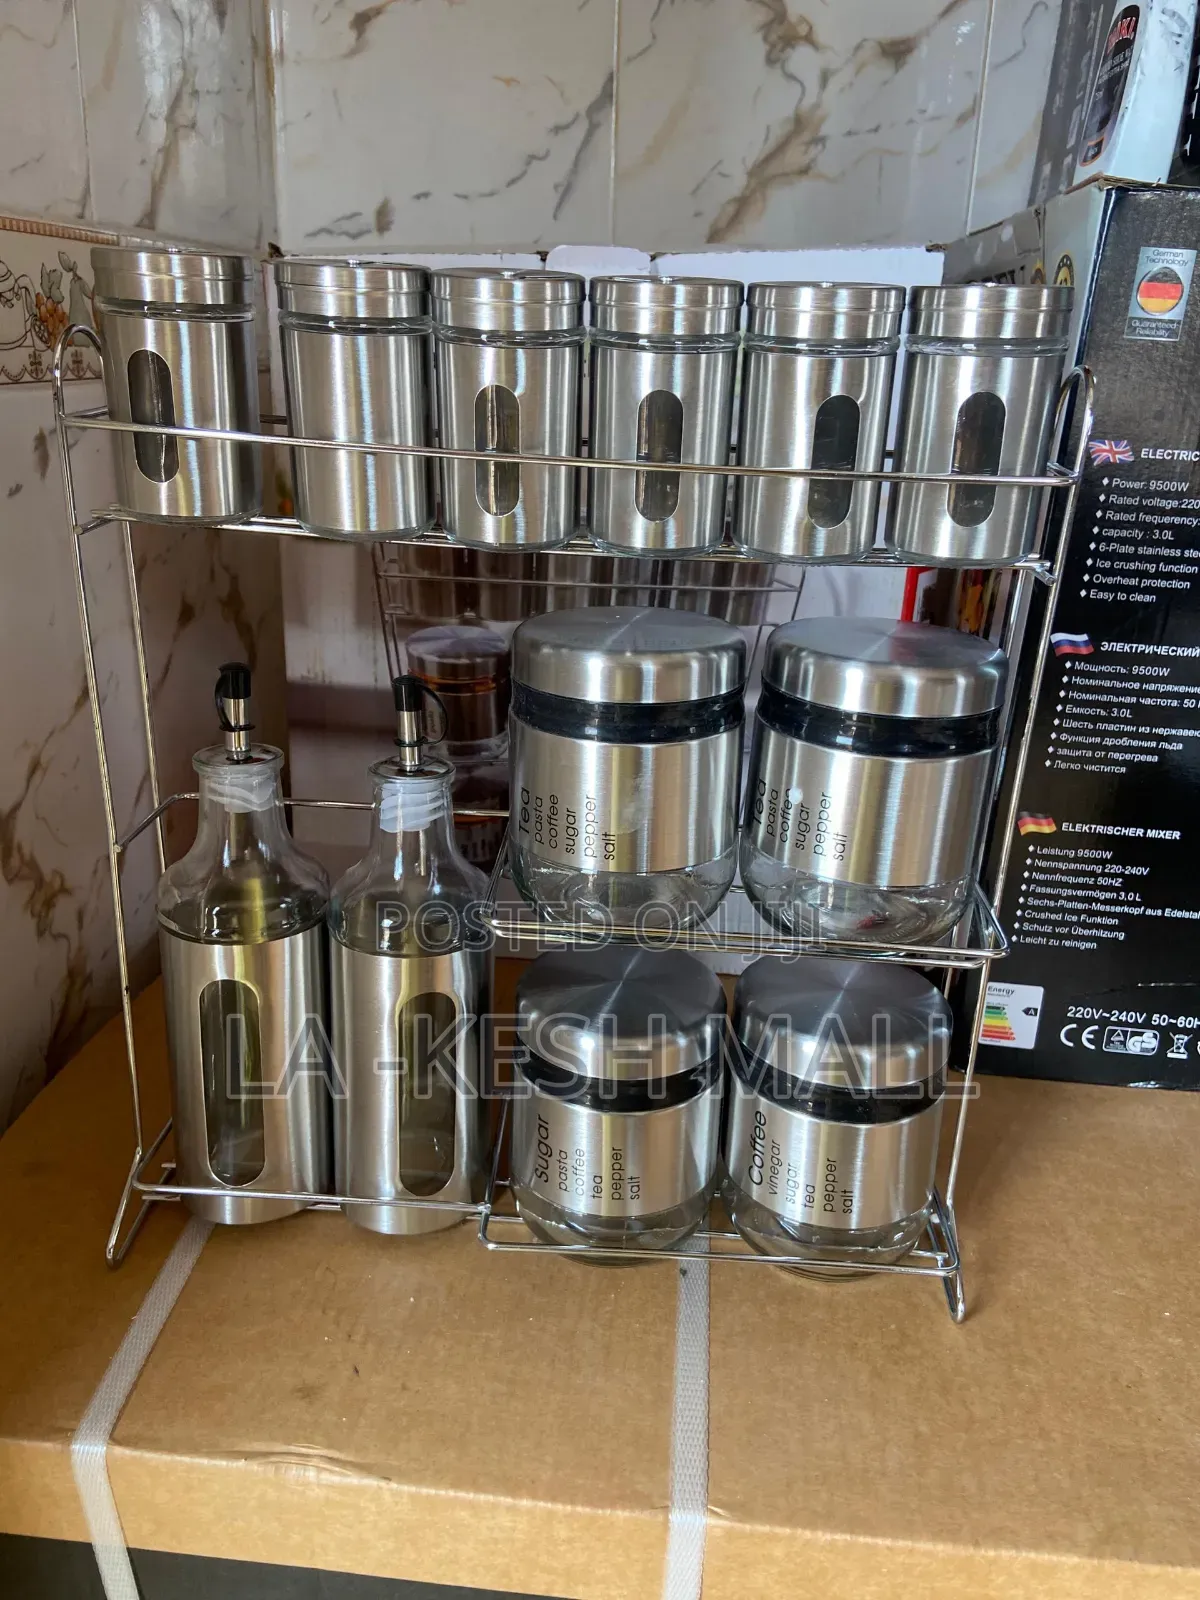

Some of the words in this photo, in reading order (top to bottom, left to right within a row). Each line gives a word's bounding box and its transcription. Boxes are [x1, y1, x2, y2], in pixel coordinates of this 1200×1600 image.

[1145, 256, 1189, 266] Technology
[1152, 249, 1184, 258] German
[1140, 448, 1200, 462] ELECTRIC
[1112, 478, 1148, 490] Power:
[1149, 480, 1190, 492] 9500W
[1108, 495, 1140, 506] Rated
[1105, 511, 1136, 522] Rated
[1102, 528, 1144, 540] capacity
[1152, 530, 1174, 540] 3.0L
[1098, 543, 1135, 554] 6-Plate
[1137, 546, 1181, 557] stainless
[1096, 558, 1112, 568] Ice
[1114, 560, 1156, 573] crushing
[1158, 562, 1198, 574] function
[1092, 574, 1139, 586] Overheat
[1140, 578, 1191, 589] protection
[1090, 589, 1114, 601] Easy
[1117, 590, 1127, 600] to
[1129, 592, 1156, 602] clean
[1100, 641, 1200, 658] ЭЛЕКТРИЧЕСКИЙ
[1074, 661, 1130, 674] Мощность:
[1132, 666, 1170, 677] 9500W
[1072, 676, 1140, 690] Номинальное
[1068, 690, 1137, 704] Номинальная
[1139, 697, 1180, 707] частота:
[1183, 699, 1195, 708] 50
[1065, 704, 1109, 716] Емкость:
[1110, 708, 1133, 718] 3.0L
[1062, 718, 1094, 730] Шесть
[1096, 722, 1136, 732] пластин
[1060, 732, 1101, 744] Функция
[1102, 736, 1156, 748] дробления
[1158, 742, 1183, 750] льда
[1056, 748, 1092, 757] защита
[1108, 752, 1159, 762] перегрева
[1054, 760, 1081, 770] Легко
[1083, 764, 1126, 774] чистится
[519, 787, 530, 834] Tea
[766, 788, 779, 838] pasta
[533, 796, 544, 845] pasta
[547, 794, 559, 849] coffee
[584, 795, 598, 858] pepper
[796, 803, 810, 850] sugar
[813, 792, 832, 857] pepper
[566, 808, 579, 855] sugar
[1061, 822, 1143, 838] ELEKTRISCHER
[1146, 829, 1181, 840] MIXER
[602, 832, 616, 861] salt
[833, 832, 848, 861] salt
[1036, 846, 1075, 859] Leistung
[1077, 849, 1113, 860] 9500W
[1034, 858, 1102, 873] Nennspannung
[1104, 864, 1150, 876] 220-240V
[1031, 871, 1095, 885] Nennfrequenz
[1097, 876, 1123, 887] 50HZ
[1029, 884, 1117, 900] Fassungsvermögen
[1026, 897, 1145, 916] Sechs-Platten-Messerkopf
[1145, 908, 1162, 916] aus
[1025, 910, 1062, 920] Crushed
[1064, 913, 1078, 922] Ice
[1080, 914, 1119, 926] Funktion
[1022, 922, 1052, 933] Schutz
[1055, 926, 1069, 934] vor
[1071, 925, 1125, 941] Überhitzung
[1020, 935, 1046, 945] Leicht
[1061, 939, 1097, 950] reinigen
[988, 986, 1015, 995] Energy
[1067, 1006, 1147, 1024] 220V~240V
[1060, 1023, 1099, 1050] CE
[1128, 1032, 1157, 1053] GS
[535, 1114, 552, 1183] Sugar
[748, 1110, 766, 1186] Coffee
[556, 1149, 570, 1193] pasta
[572, 1148, 585, 1196] coffee
[611, 1147, 625, 1200] pepper
[768, 1139, 782, 1196] vinegar
[590, 1175, 603, 1200] tea
[628, 1176, 640, 1200] salt
[786, 1163, 799, 1204] sugar
[823, 1158, 838, 1213] pepper
[803, 1184, 816, 1209] tea
[841, 1190, 853, 1214] salt
